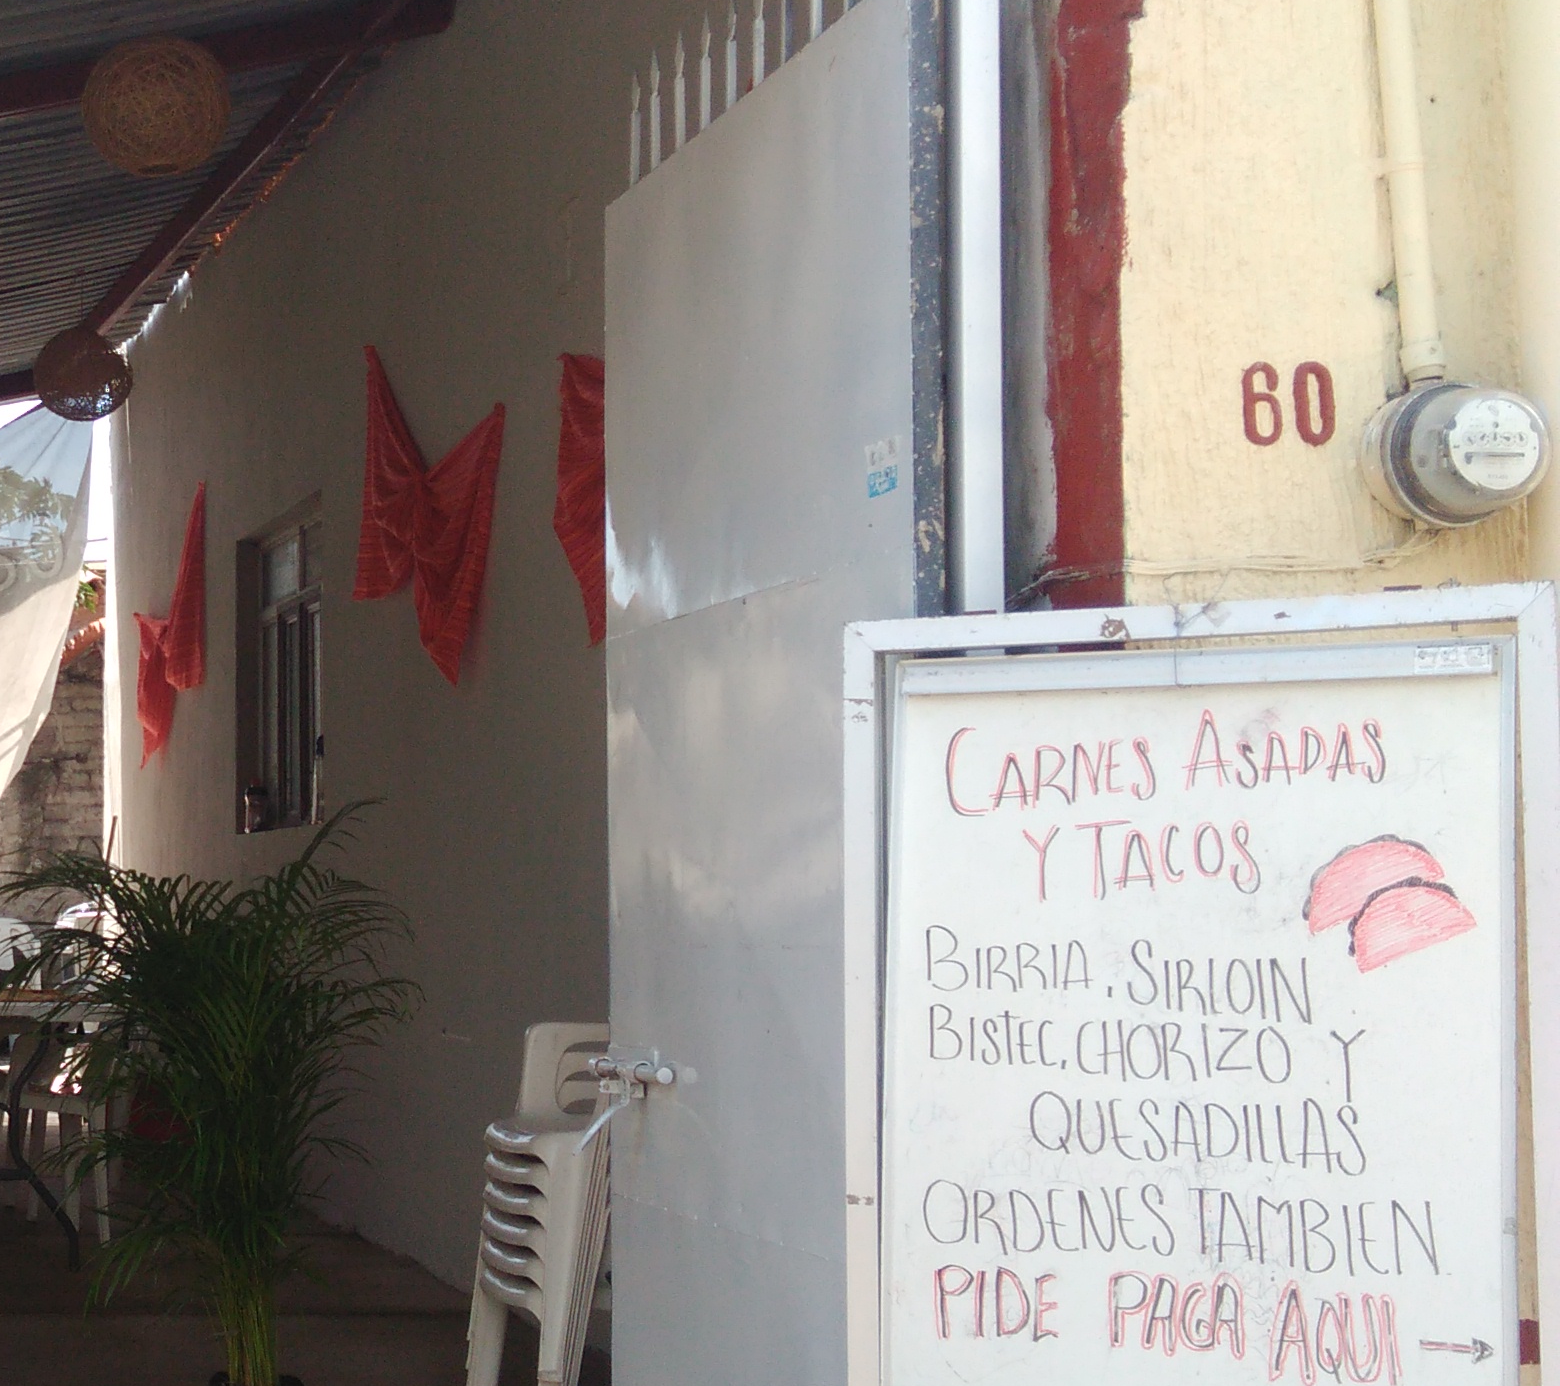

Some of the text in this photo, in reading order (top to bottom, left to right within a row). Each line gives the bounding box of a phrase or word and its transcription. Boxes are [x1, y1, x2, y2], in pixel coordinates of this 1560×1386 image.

[1243, 360, 1336, 447] 60
[946, 709, 1386, 816] CARNES ASADAS
[1023, 820, 1261, 901] Y TACOS
[1127, 939, 1312, 1025] SIRLOIN
[1076, 1020, 1291, 1084] CHORIZO
[1330, 1029, 1366, 1102] Y
[1030, 1091, 1367, 1176] QUESADILLAS
[923, 1179, 1440, 1277] ORDENES TAMBIEN
[933, 1264, 1059, 1341] PIDE
[1108, 1270, 1245, 1360] PAGA
